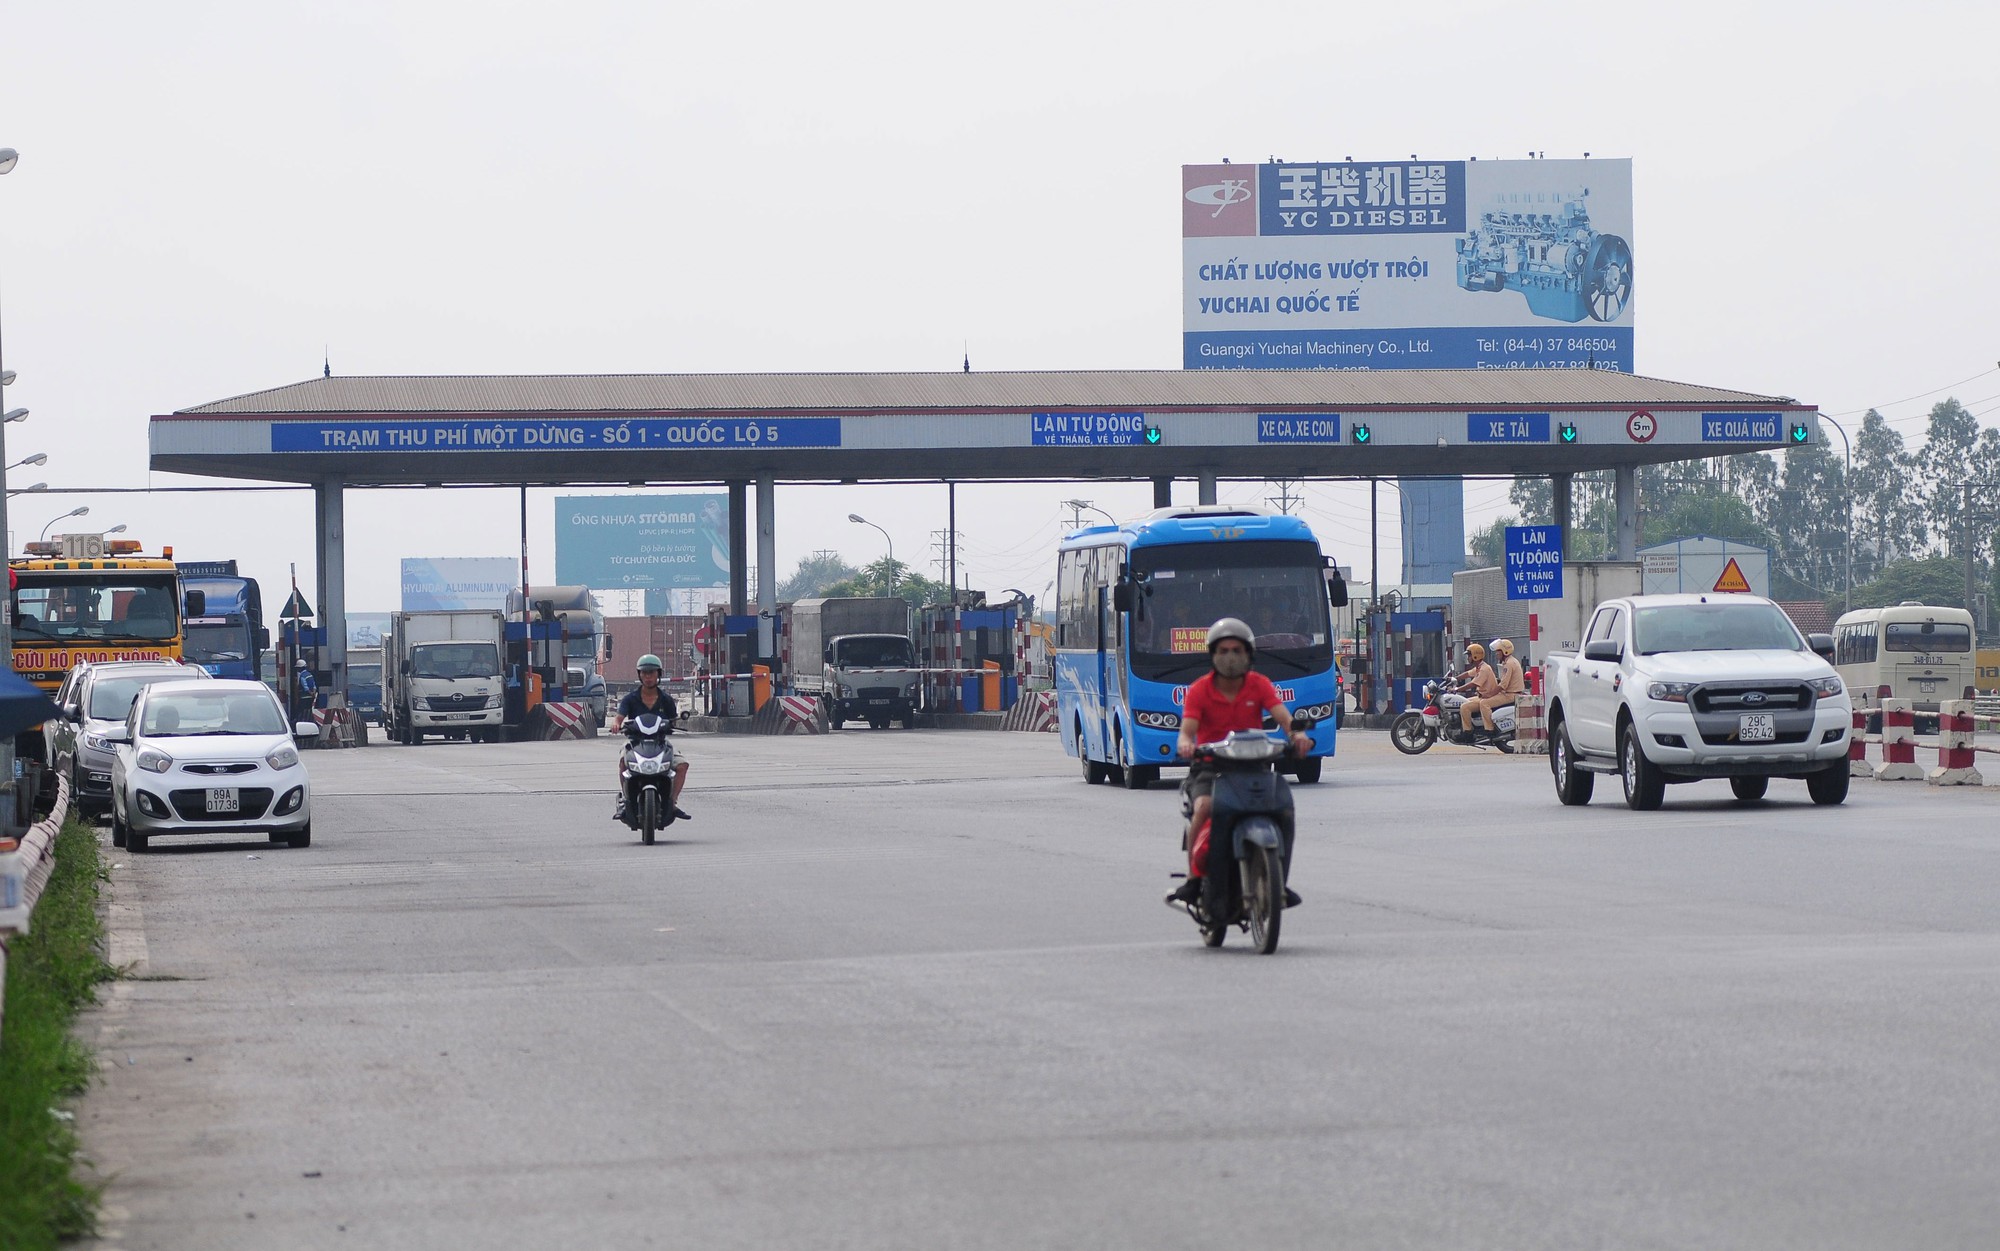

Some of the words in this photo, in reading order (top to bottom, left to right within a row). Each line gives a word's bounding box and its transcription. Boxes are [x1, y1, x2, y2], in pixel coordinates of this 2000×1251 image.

[1278, 165, 1447, 208] 玉柴机器
[1280, 211, 1318, 228] YC
[1330, 210, 1447, 228] DIESEL
[1199, 256, 1248, 281] CHẤT
[1255, 260, 1321, 285] LƯỢNG
[1328, 259, 1379, 283] VƯỢT
[1385, 256, 1429, 282] TRỘI
[1199, 297, 1270, 314] YUCHAI
[1276, 289, 1330, 314] QUỐC
[1336, 288, 1360, 312] TẾ
[1200, 342, 1254, 359] Guangxi
[1258, 341, 1302, 355] Yuchai
[1307, 340, 1374, 357] Machinery
[1378, 340, 1405, 355] Co.,
[1409, 339, 1433, 353] Ltd.
[1477, 338, 1499, 352] Tel:
[1503, 338, 1543, 354] (84-4)
[1547, 338, 1563, 352] 37
[1567, 338, 1617, 352] 846504
[1033, 413, 1067, 432] LÀN
[1071, 415, 1094, 435] TỰ
[1096, 413, 1143, 435] ĐỘNG
[1261, 420, 1275, 437] XE
[1312, 420, 1334, 437] CON
[1489, 421, 1504, 437] XE
[1510, 416, 1529, 437] TẢI
[1707, 421, 1722, 437] XE
[1725, 419, 1749, 438] QUÁ
[1752, 416, 1776, 437] KHỔ
[321, 429, 380, 450] TRẠM
[386, 429, 427, 445] THU
[435, 424, 467, 445] PHÍ
[473, 424, 518, 449] MỘT
[523, 422, 584, 444] DỪNG
[603, 421, 631, 443] SỐ
[637, 428, 647, 443] 1
[667, 420, 726, 443] QUỐC
[735, 422, 761, 447] LỘ
[767, 426, 778, 442] 5
[1060, 433, 1093, 445] THÁNG,
[571, 512, 598, 525] ỐNG
[601, 513, 636, 526] NHỰA
[1522, 528, 1546, 545] LÀN
[65, 535, 102, 557] 116
[1508, 550, 1525, 568] TỰ
[1526, 548, 1560, 568] ĐỘNG
[1526, 569, 1554, 580] THÁNG
[446, 583, 493, 593] ALUMINUM
[496, 583, 511, 592] VIN
[1189, 629, 1207, 640] ĐÔN
[1191, 642, 1207, 651] NGH
[15, 649, 44, 669] CỨU
[50, 648, 70, 671] HỘ
[1748, 715, 1766, 727] 29C
[213, 789, 231, 800] 89A
[207, 799, 238, 811] 017.38
